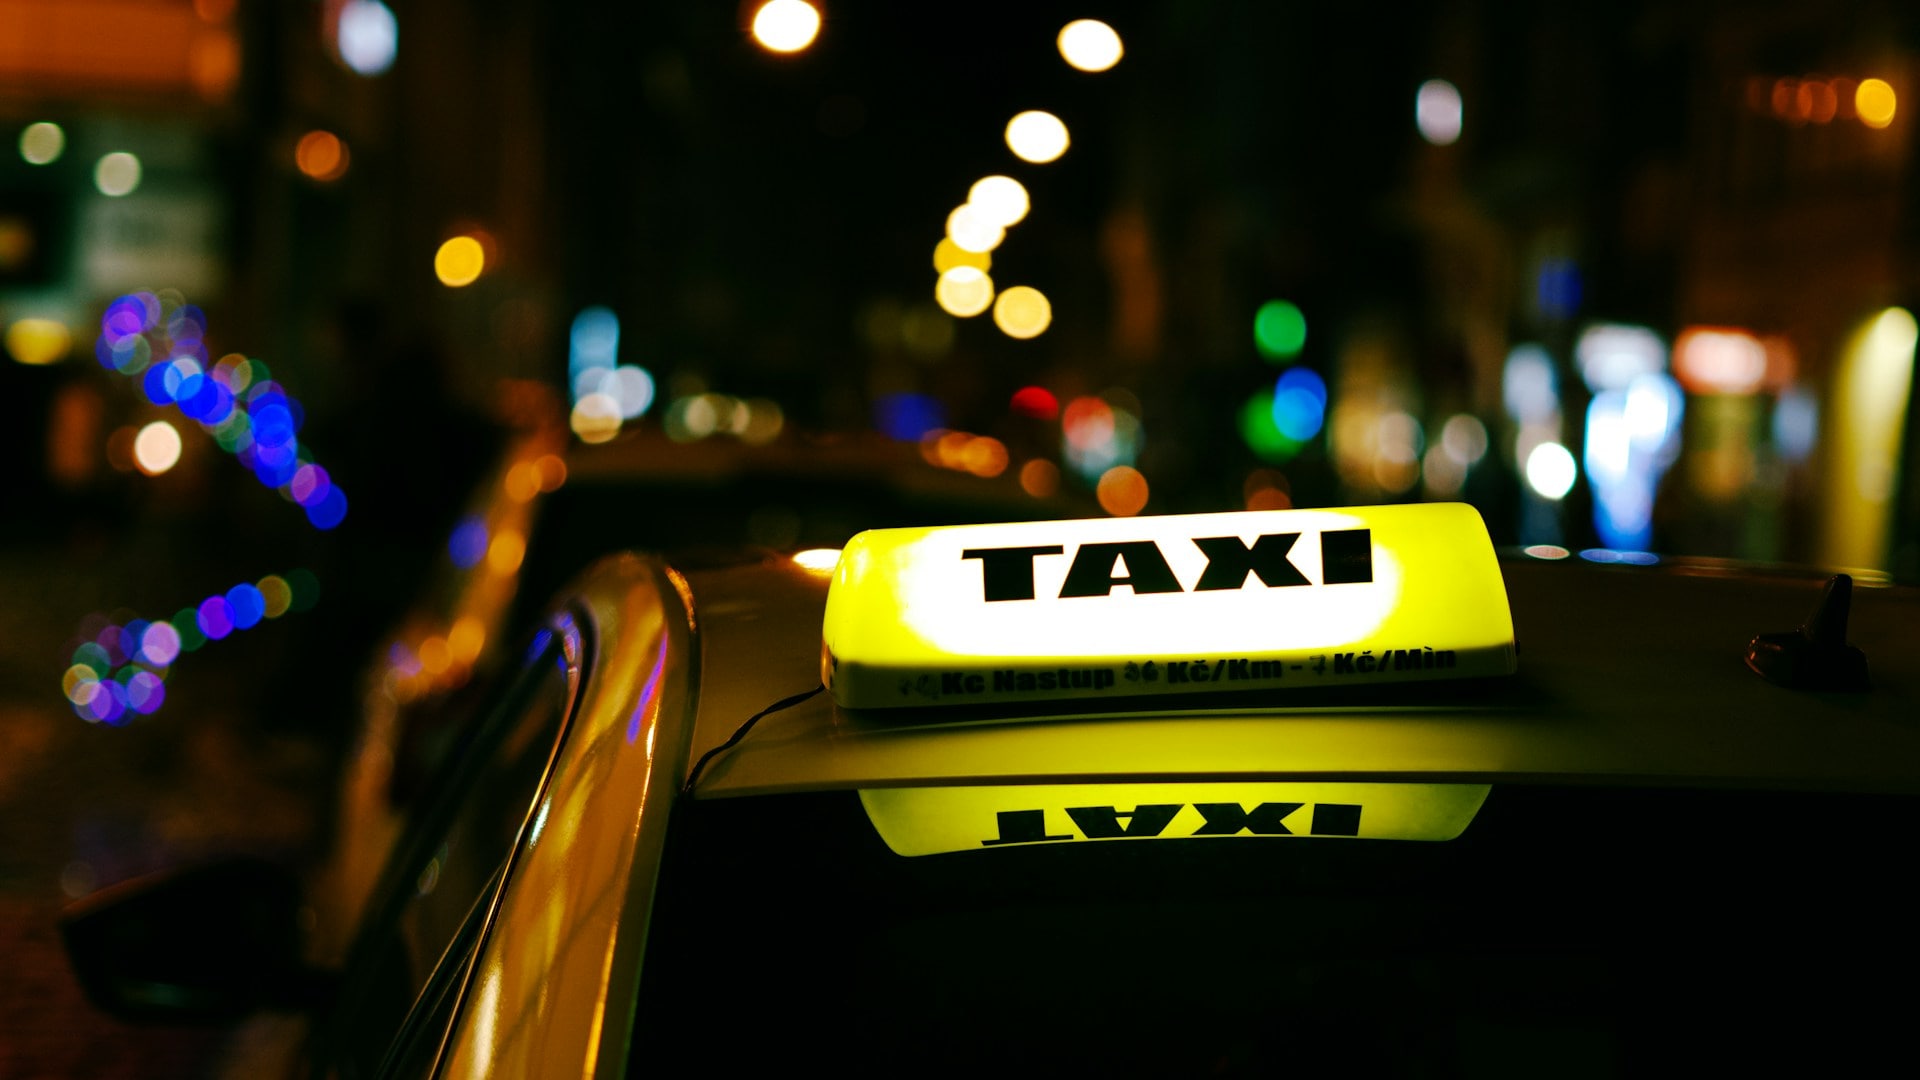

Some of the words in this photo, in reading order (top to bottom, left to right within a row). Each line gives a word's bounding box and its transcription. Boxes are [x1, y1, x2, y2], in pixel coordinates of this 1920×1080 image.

[963, 529, 1372, 602] TAXI
[993, 668, 1114, 691] Nastup
[1167, 659, 1282, 683] Kč/Km
